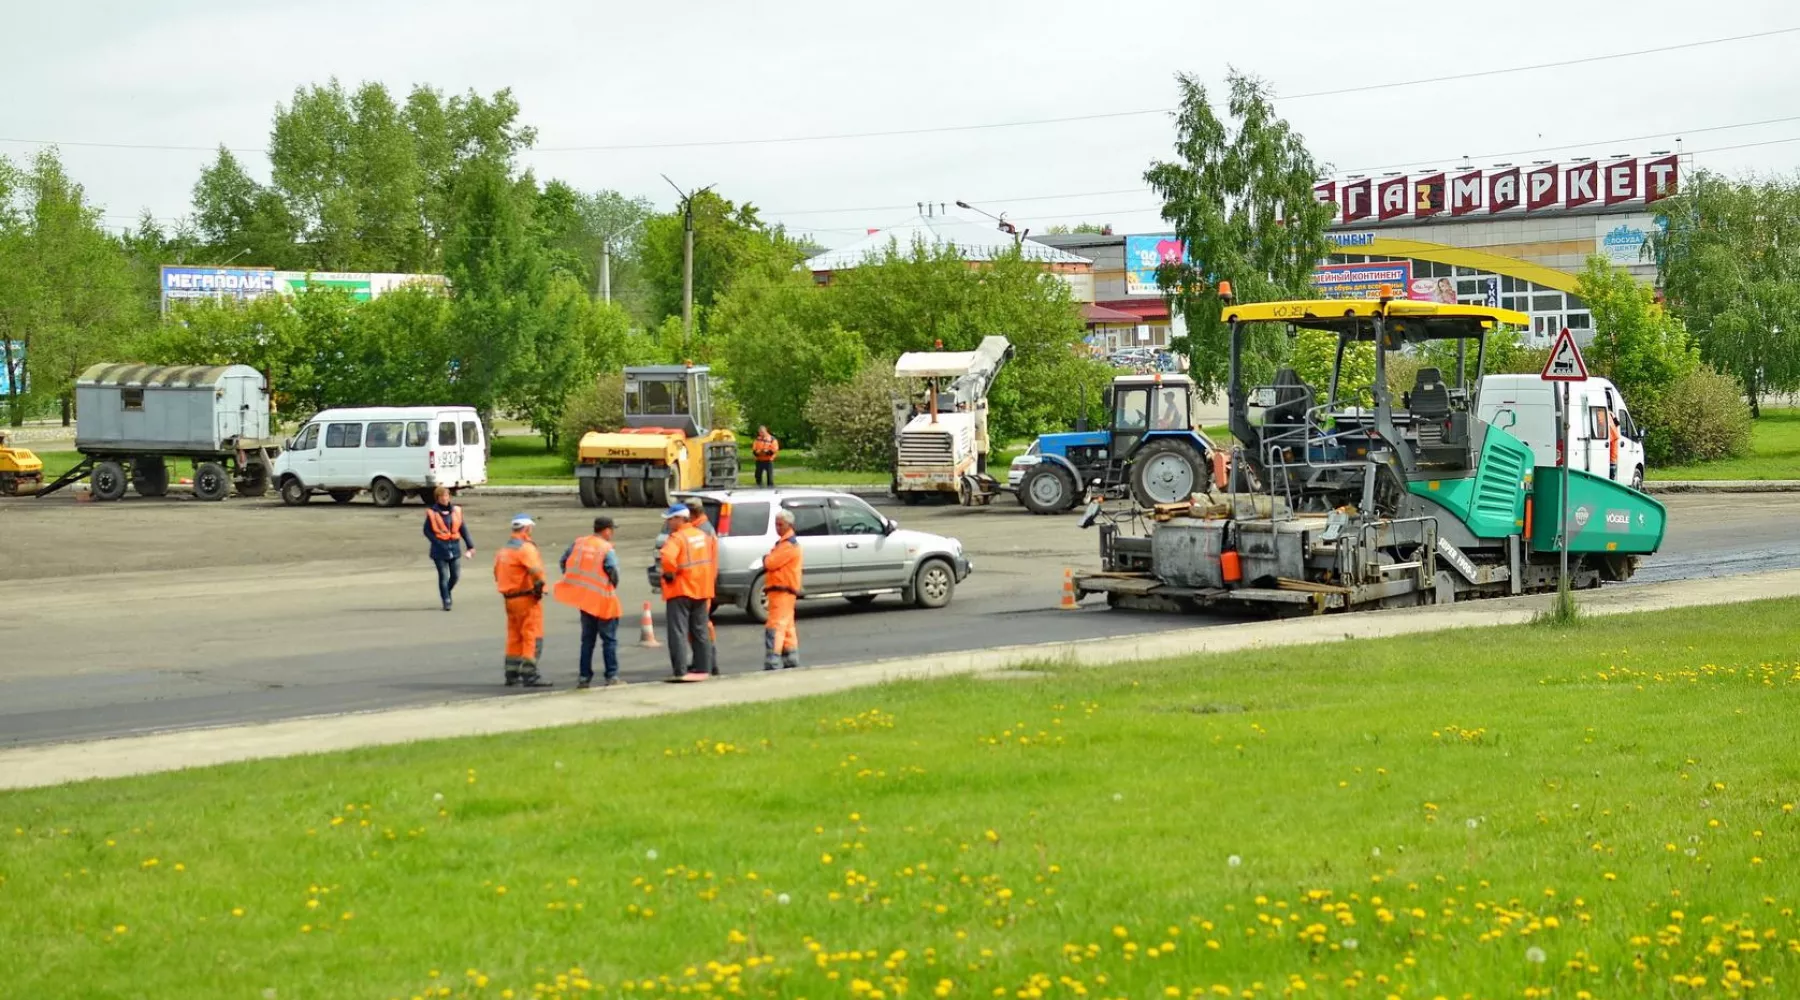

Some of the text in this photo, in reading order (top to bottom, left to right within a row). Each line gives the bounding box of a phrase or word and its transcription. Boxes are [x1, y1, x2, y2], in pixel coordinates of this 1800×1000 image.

[167, 274, 273, 290] МЕГАПОЛИС
[1351, 270, 1403, 282] КОНТИНЕНТ
[1606, 512, 1630, 523] VÖGELE
[1437, 536, 1458, 560] SUPER
